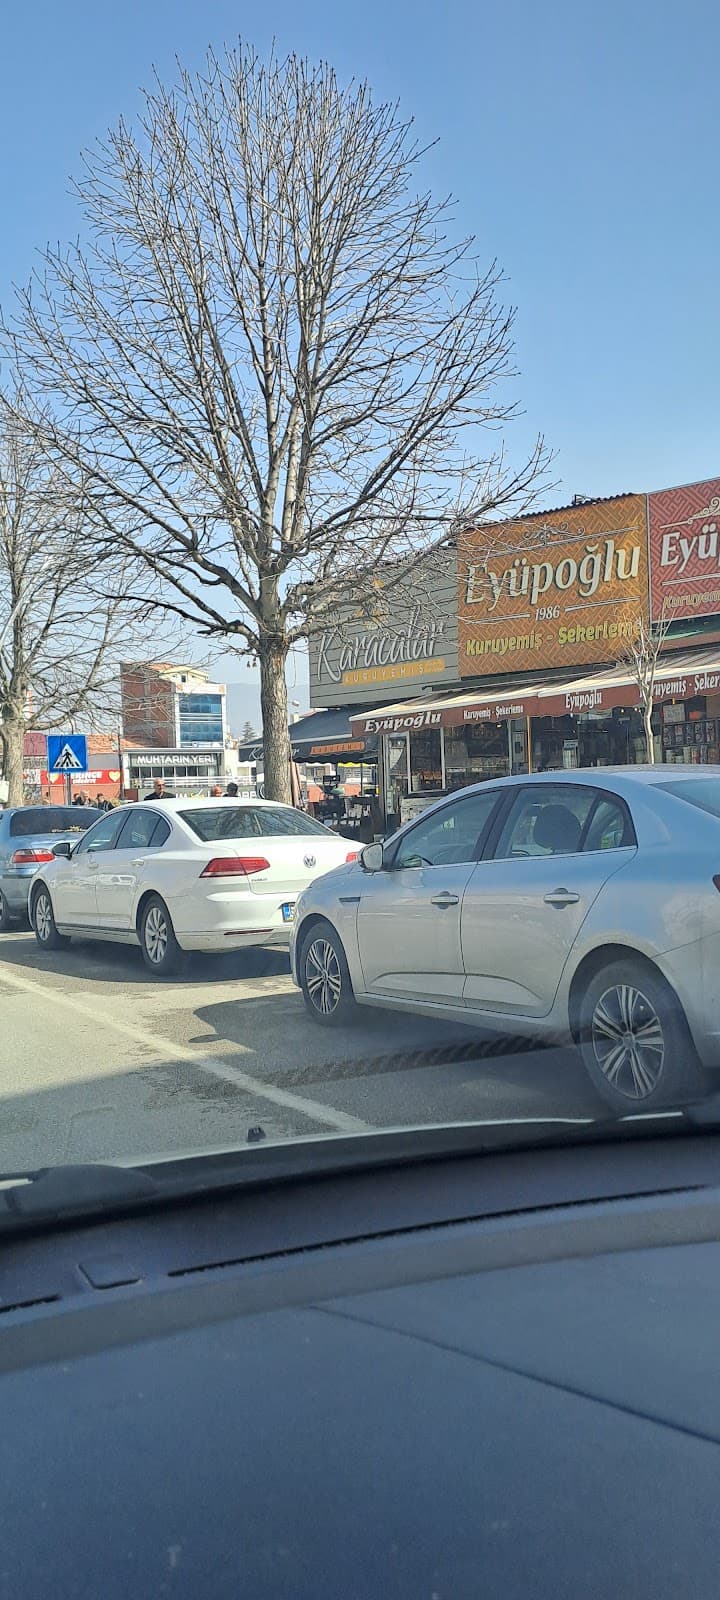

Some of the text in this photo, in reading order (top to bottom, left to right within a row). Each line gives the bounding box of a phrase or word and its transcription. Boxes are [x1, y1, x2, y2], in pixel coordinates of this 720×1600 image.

[661, 523, 720, 573] Eyü
[466, 539, 641, 611] Eyüpoğlu
[535, 606, 560, 621] 1986
[466, 631, 542, 656] Kuruyemiş
[558, 618, 643, 647] Şekerleme
[565, 690, 602, 710] Eyüpoğlu
[364, 711, 442, 733] Eyüpoğlu
[463, 707, 491, 720] Kuruyemiş
[495, 704, 524, 718] Şekerleme
